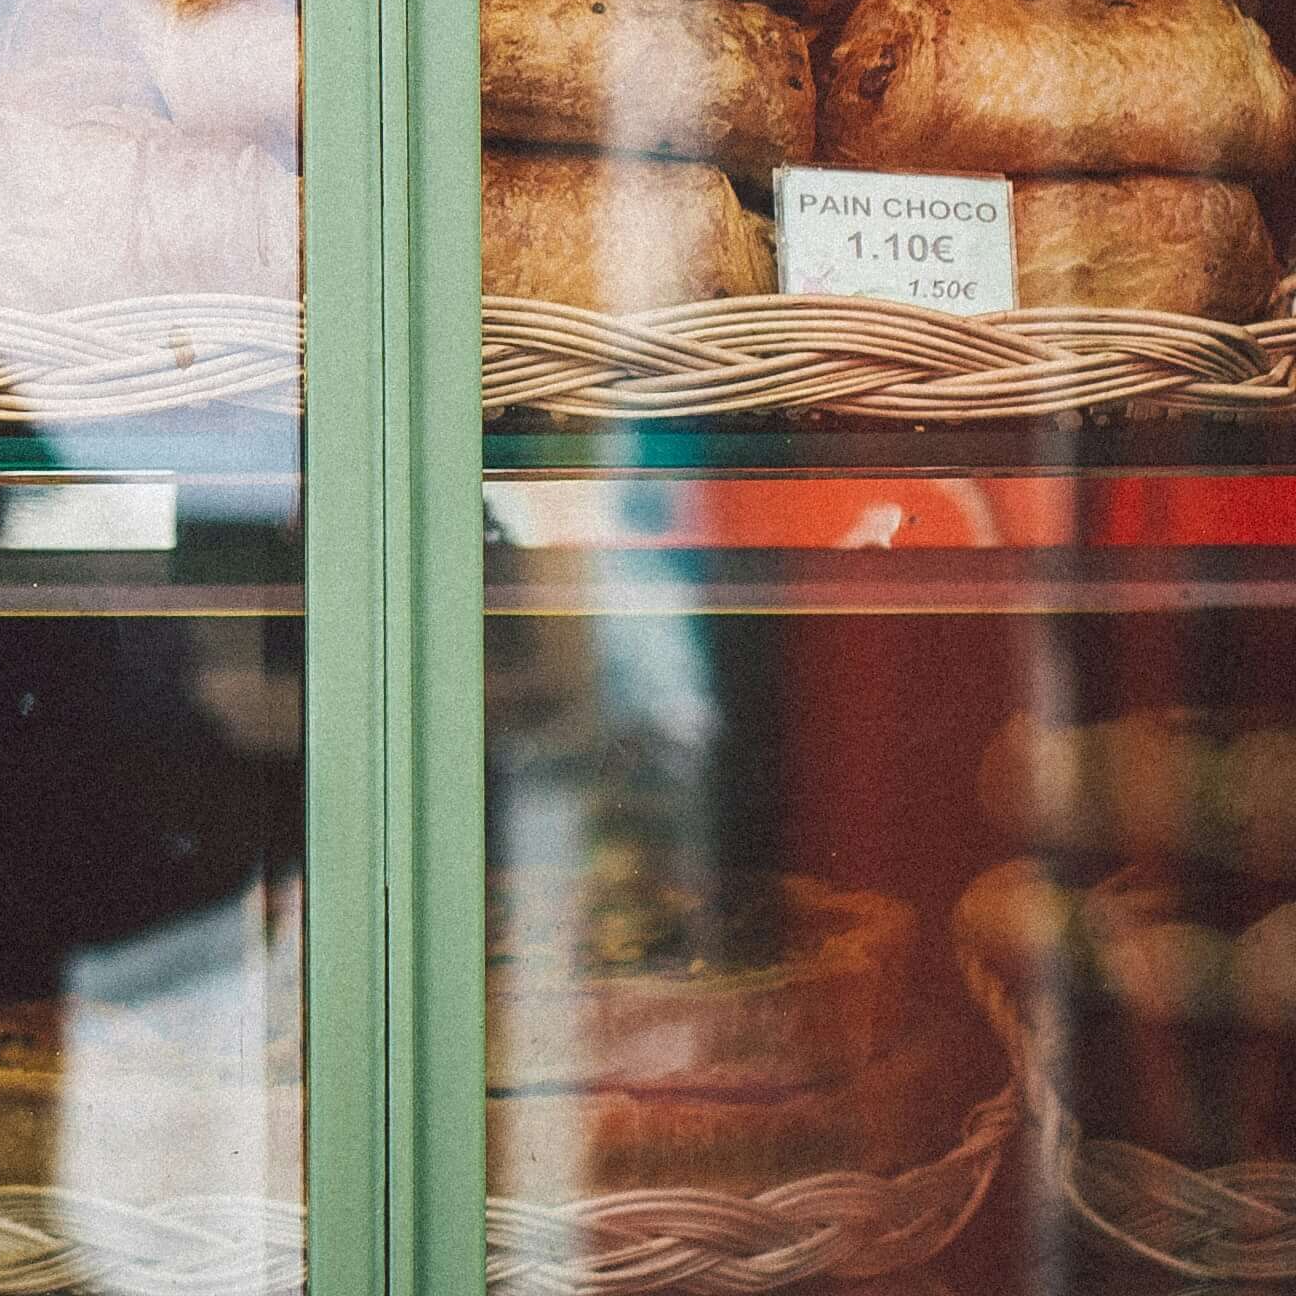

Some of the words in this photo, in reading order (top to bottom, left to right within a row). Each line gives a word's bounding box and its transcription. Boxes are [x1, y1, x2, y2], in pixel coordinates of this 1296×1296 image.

[799, 194, 872, 217] PAIN
[883, 197, 998, 223] CHOCO
[847, 231, 955, 264] 1.10€
[908, 279, 979, 301] 1.50€
